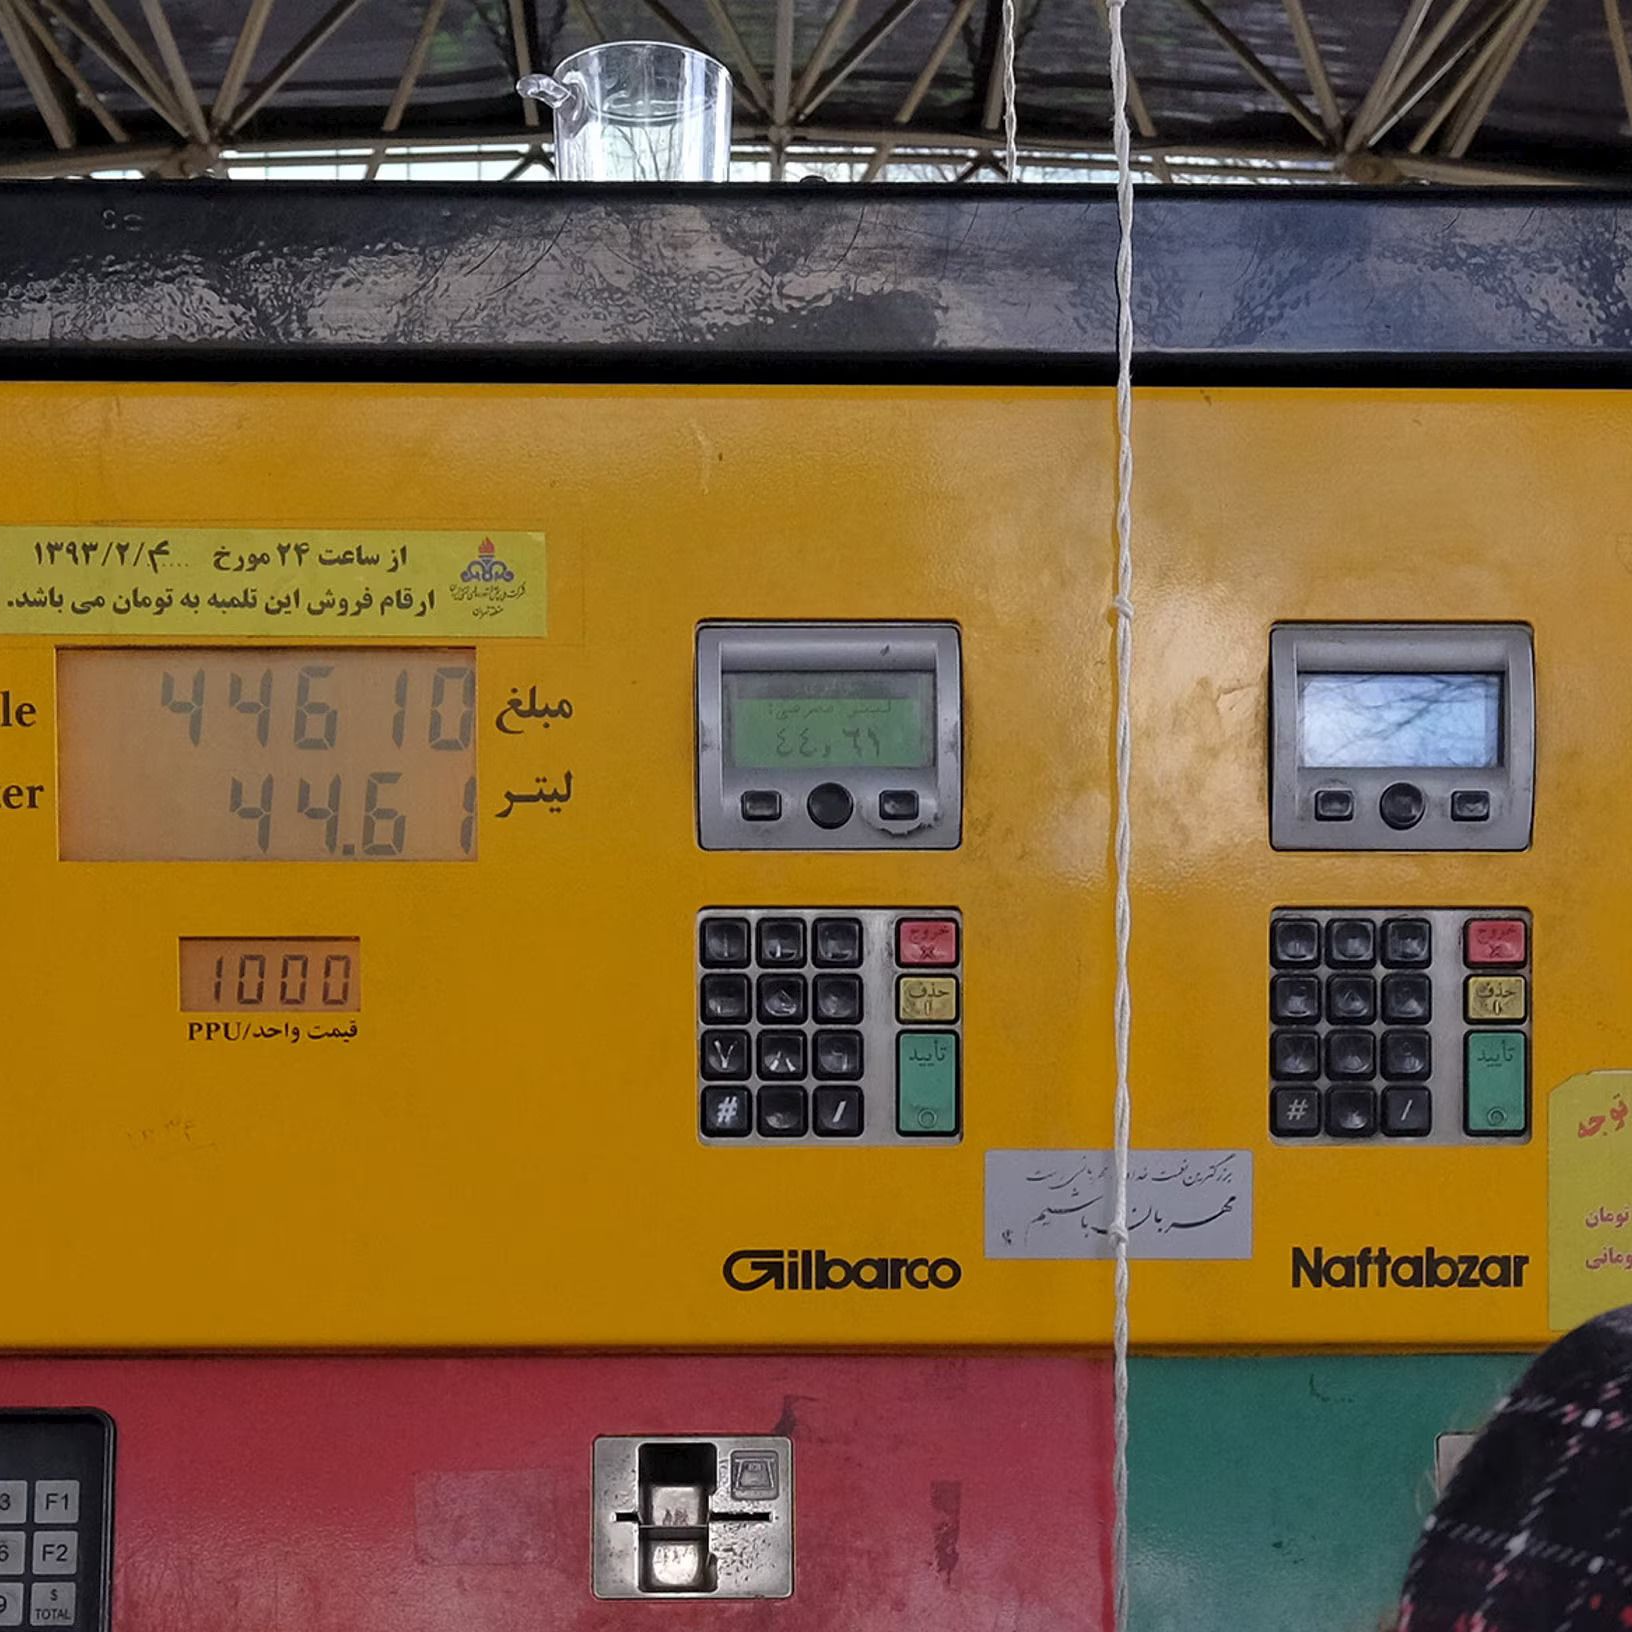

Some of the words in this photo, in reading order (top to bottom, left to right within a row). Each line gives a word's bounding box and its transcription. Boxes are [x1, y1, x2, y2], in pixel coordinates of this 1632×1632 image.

[212, 543, 270, 571] مورخ
[277, 543, 309, 567] ۲۴
[318, 543, 381, 568] ساعت
[389, 545, 407, 571] از
[6, 590, 64, 615] باشد.
[68, 592, 106, 617] می
[114, 590, 173, 617] تومان
[178, 594, 200, 615] به
[207, 590, 258, 616] تلمبه
[264, 590, 301, 616] این
[306, 590, 374, 617] فروش
[379, 589, 436, 618] ارقام
[494, 685, 574, 734] مبلغ
[494, 770, 574, 818] لیتر
[229, 770, 475, 857] 44.61
[213, 953, 353, 1006] 1000
[908, 981, 950, 1000] حذف
[1476, 981, 1517, 1000] حذف
[305, 1017, 358, 1042] قیمت
[1577, 1092, 1630, 1139] توجه
[1585, 1206, 1630, 1228] تومان
[721, 1248, 963, 1292] Gilbarco
[1290, 1246, 1529, 1290] Naftabzar
[45, 1493, 69, 1511] F1
[42, 1545, 68, 1562] F2
[35, 1608, 70, 1620] TOTAL
